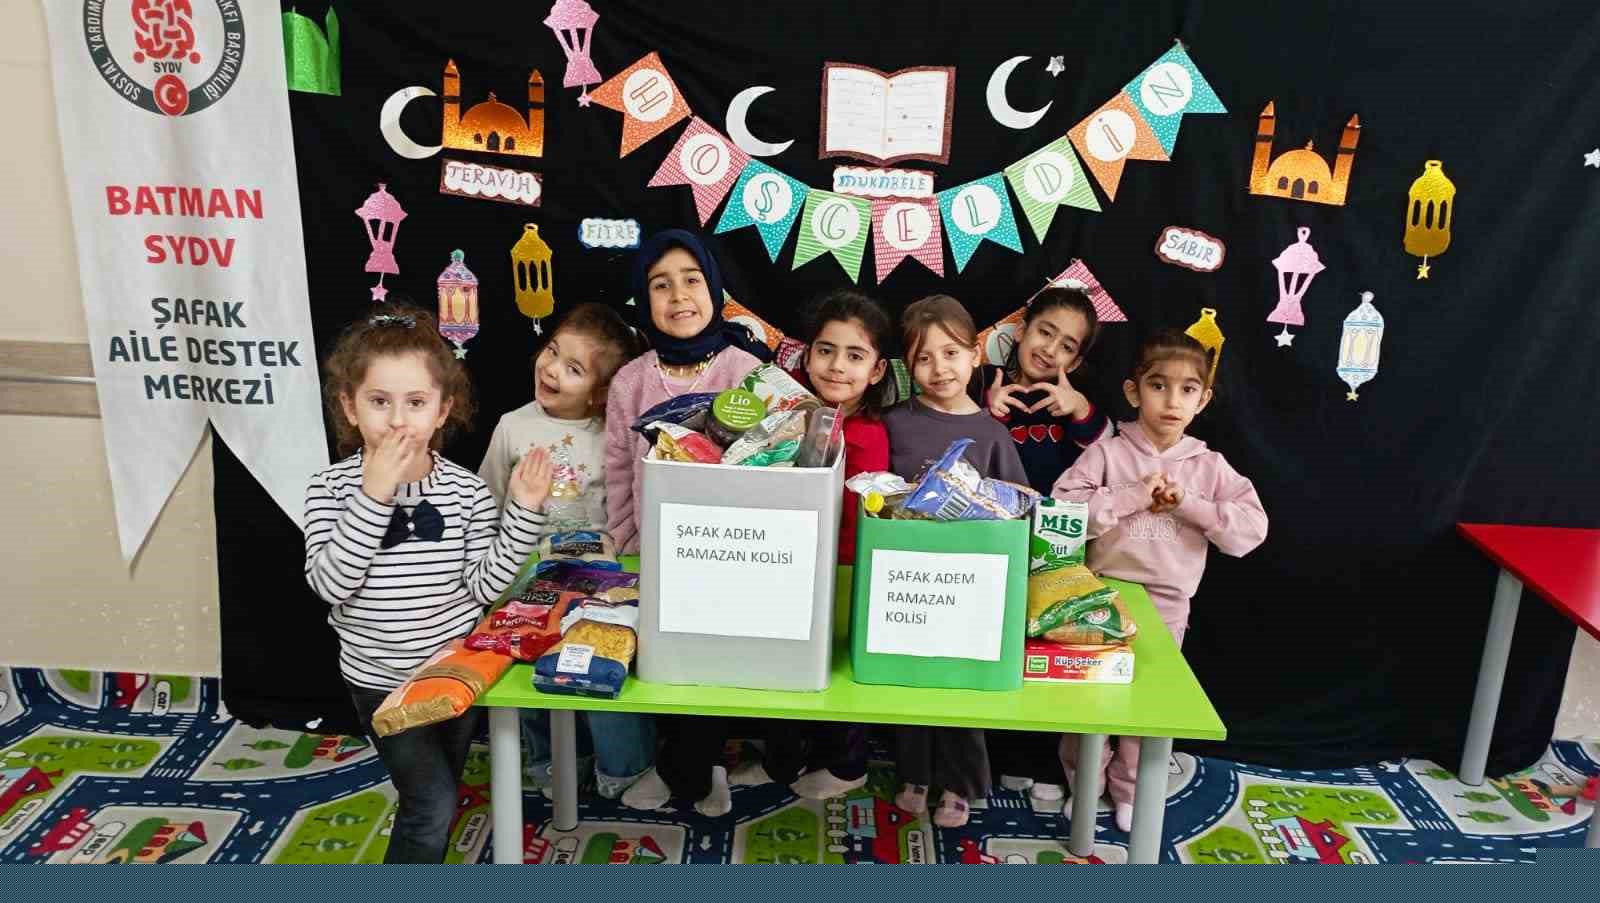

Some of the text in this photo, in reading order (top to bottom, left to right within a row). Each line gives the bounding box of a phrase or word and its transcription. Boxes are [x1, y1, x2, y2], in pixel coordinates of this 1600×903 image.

[220, 0, 240, 23] KFI
[87, 0, 140, 100] SOSYAL YARDIM
[153, 62, 182, 73] SYDV
[106, 186, 264, 219] BATMAN
[145, 235, 236, 268] SYDV
[152, 298, 247, 330] ŞAFAK
[109, 330, 301, 367] AİLE DESTEK
[144, 373, 274, 405] MERKEZİ
[729, 394, 751, 406] Lio
[676, 524, 766, 541] ŞAFAK ADEM
[676, 547, 793, 564] RAMAZAN KOLİSİ
[887, 569, 976, 585] ŞAFAK ADEM
[887, 591, 956, 606] RAMAZAN
[885, 610, 928, 625] KOLİSİ
[157, 691, 168, 709] car
